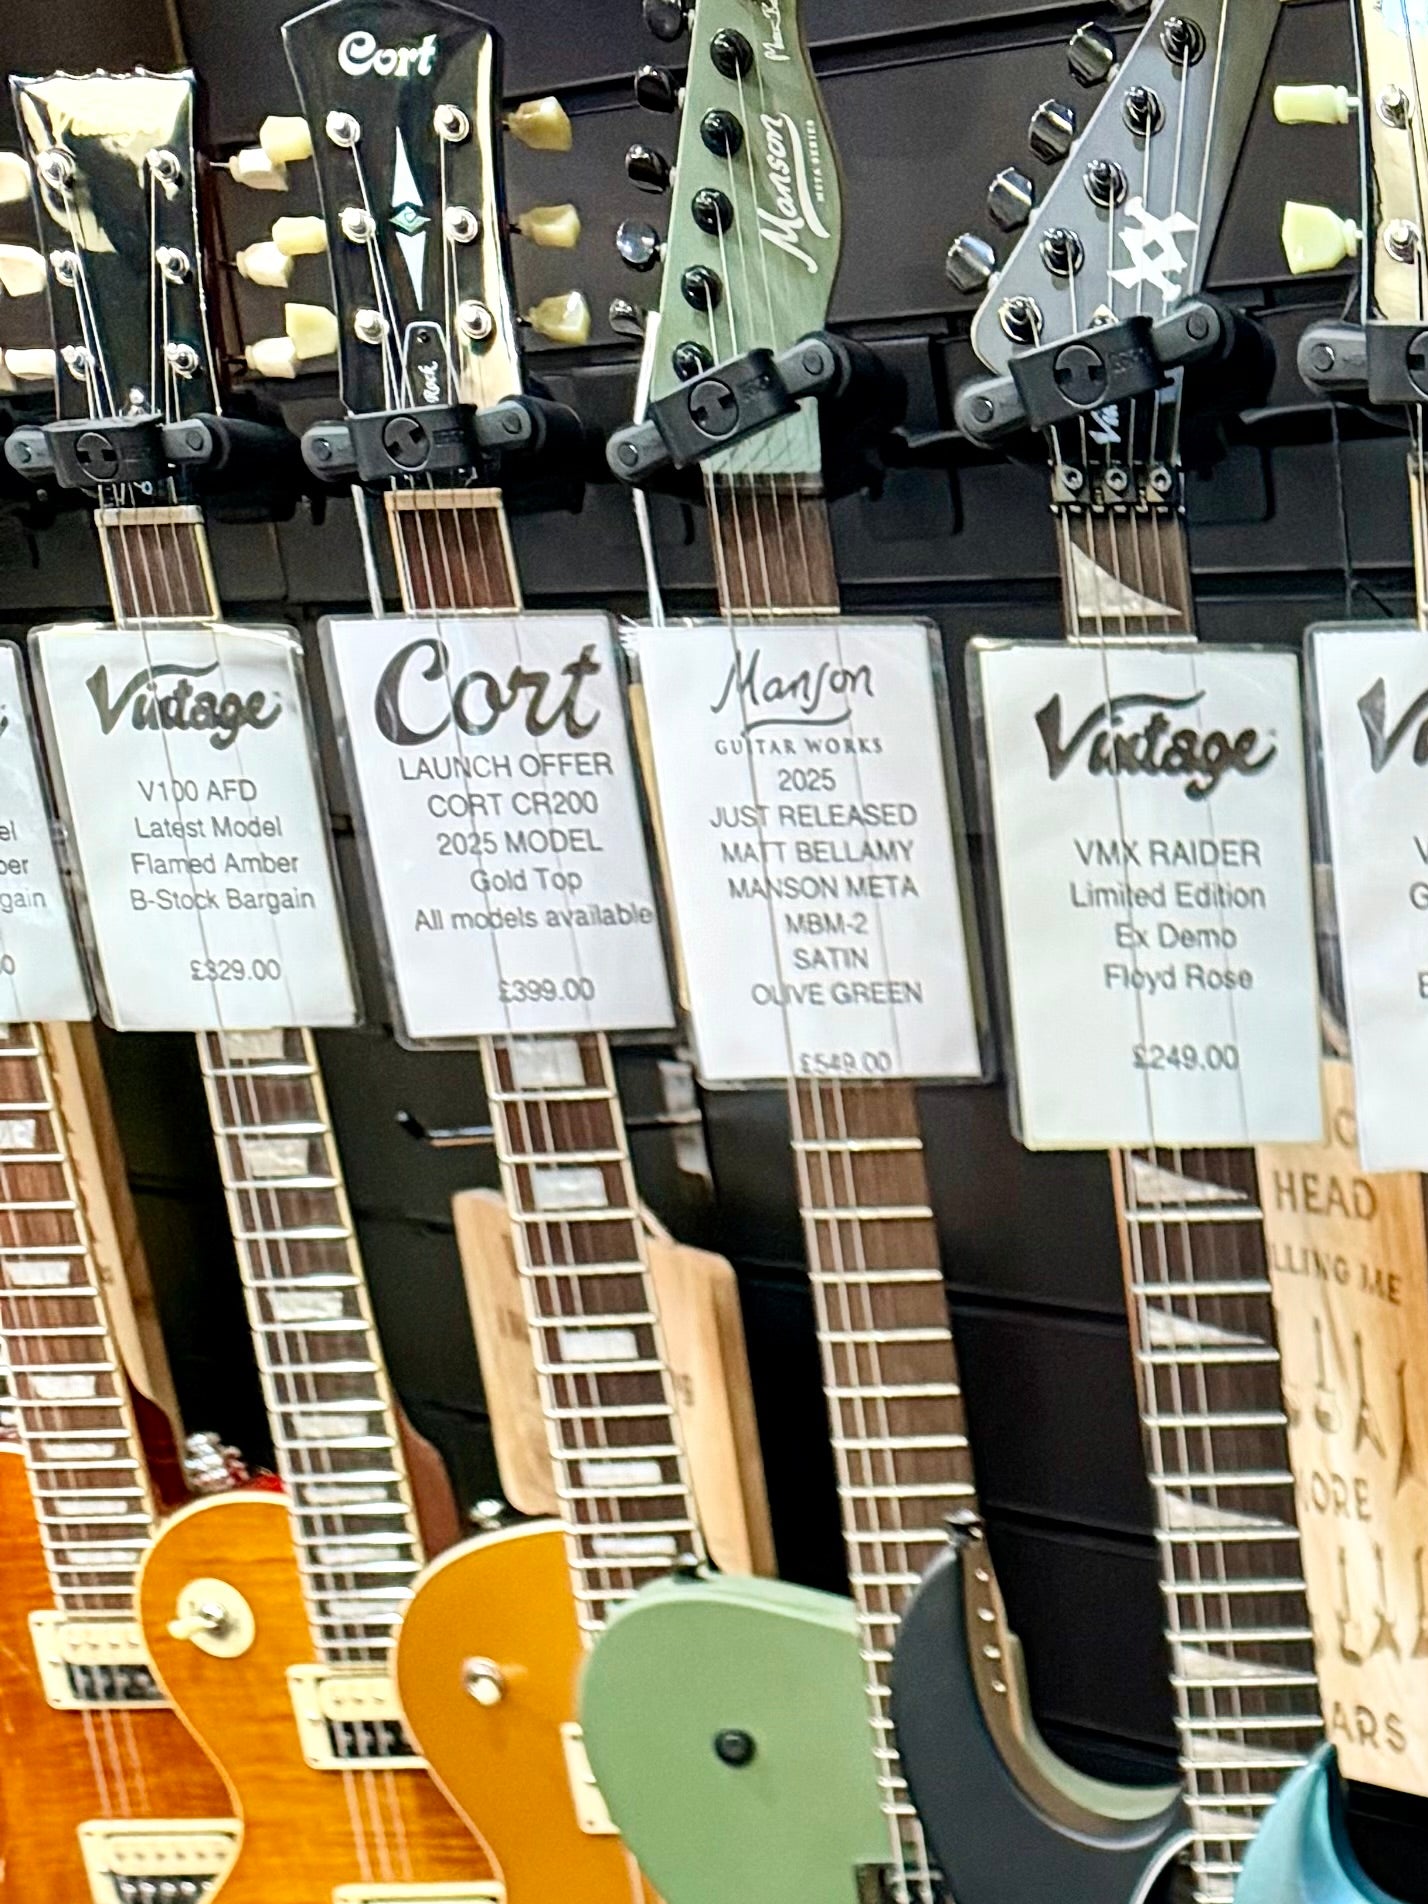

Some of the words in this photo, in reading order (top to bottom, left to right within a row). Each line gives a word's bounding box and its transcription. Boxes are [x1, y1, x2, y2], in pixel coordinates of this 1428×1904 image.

[338, 31, 438, 77] Cort
[757, 113, 818, 273] Manson
[374, 638, 602, 747] Cort
[710, 648, 876, 716] Manson
[86, 660, 283, 751] Vintage
[715, 738, 797, 756] GUITAR
[804, 737, 884, 755] WORKS
[1034, 690, 1278, 801] Vintage
[399, 756, 512, 781] LAUNCH
[518, 752, 614, 777] OFFER
[138, 779, 199, 802] V100
[207, 778, 257, 801] AFD
[778, 769, 836, 792] 2025
[428, 794, 502, 816] CORT
[509, 791, 599, 815] CR200
[709, 806, 768, 828] JUST
[779, 804, 917, 827] RELEASED
[135, 816, 206, 839] Latest
[212, 815, 283, 838] Model
[436, 833, 498, 857] 2025
[504, 831, 602, 853] MODEL
[721, 842, 786, 864] MATT
[797, 840, 914, 863] BELLAMY
[1073, 840, 1142, 867] VMX
[1149, 839, 1262, 867] RAIDER
[131, 852, 219, 874] Flamed
[224, 851, 300, 874] Amber
[470, 868, 530, 894] Gold
[537, 867, 583, 894] Top
[728, 877, 840, 900] MANSON
[845, 875, 919, 897] META
[130, 887, 220, 911] B-Stock
[226, 888, 316, 914] Bargain
[1070, 881, 1167, 909] Limited
[1176, 881, 1266, 909] Edition
[414, 908, 445, 931] All
[451, 906, 539, 930] models
[545, 903, 655, 928] available
[785, 912, 868, 934] MBM-2
[1115, 923, 1150, 949] Ex
[1158, 923, 1238, 949] Demo
[792, 947, 869, 971] SATIN
[498, 977, 596, 1003] £399.00
[1103, 963, 1177, 993] Floyd
[1185, 962, 1254, 991] Rose
[751, 983, 825, 1006] OLIVE
[831, 982, 923, 1005] GREEN
[1132, 1043, 1240, 1071] £249.00
[1273, 1169, 1379, 1222] HEAD
[1360, 1261, 1402, 1306] ME
